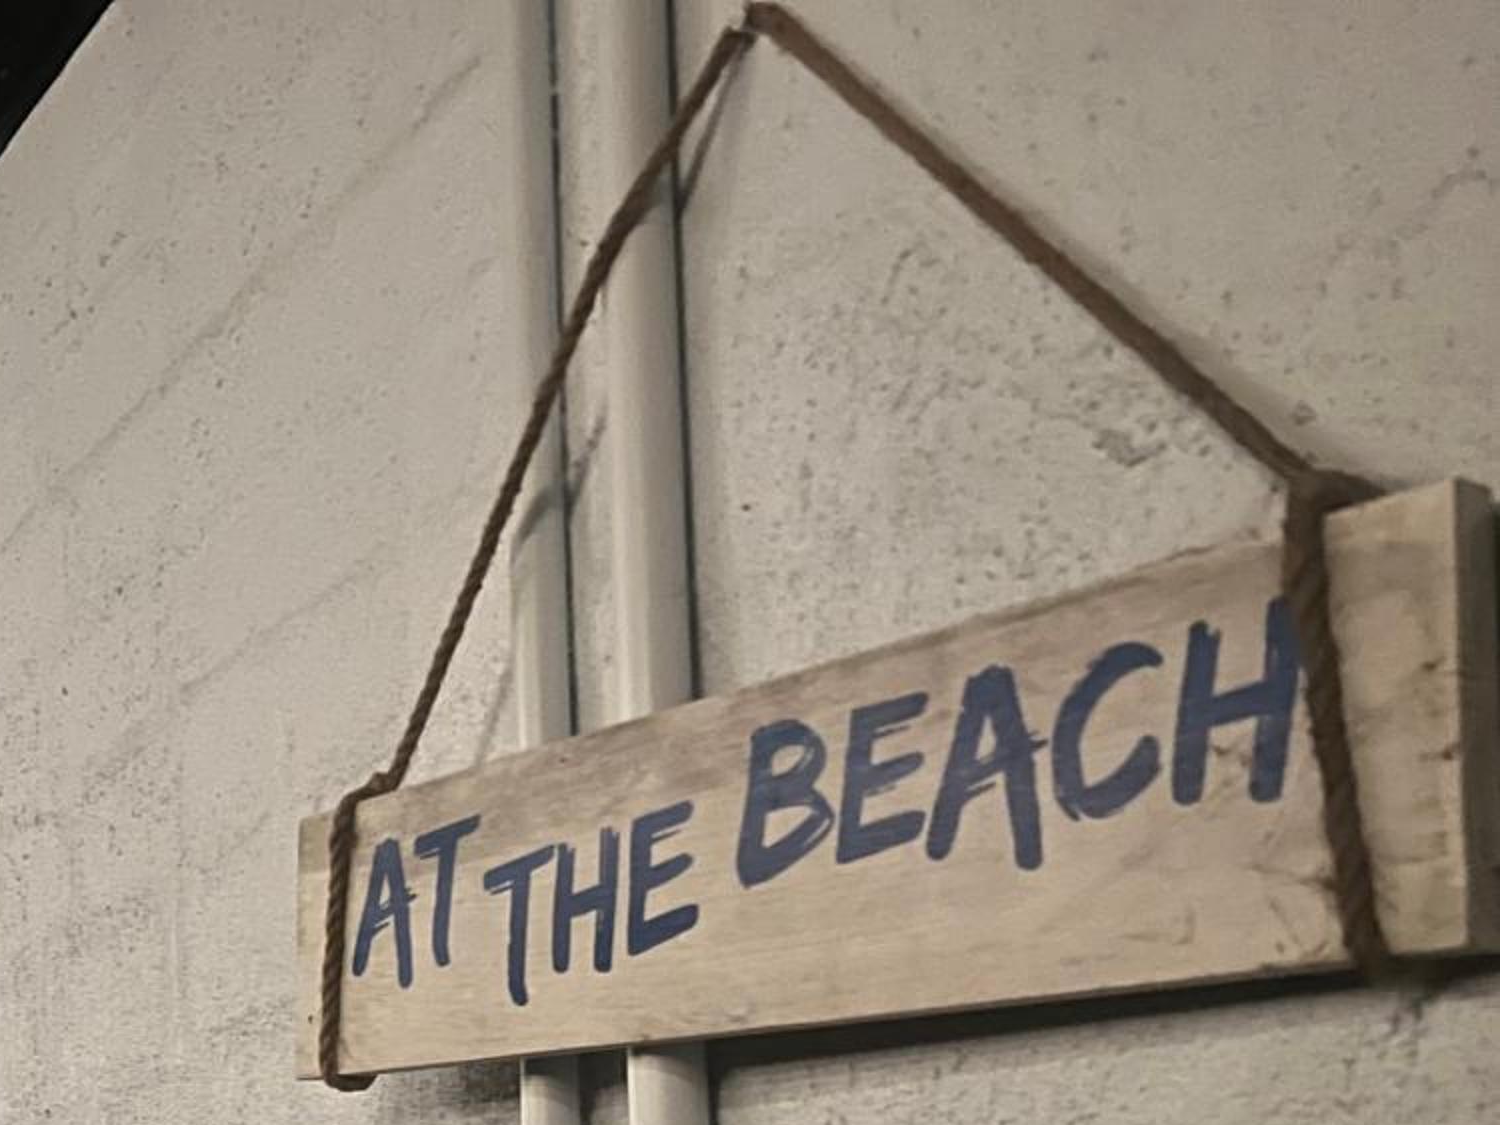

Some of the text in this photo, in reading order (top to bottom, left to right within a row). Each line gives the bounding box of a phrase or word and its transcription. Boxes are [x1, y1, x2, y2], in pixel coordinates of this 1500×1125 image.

[352, 596, 1301, 1005] AT THE BEACH
